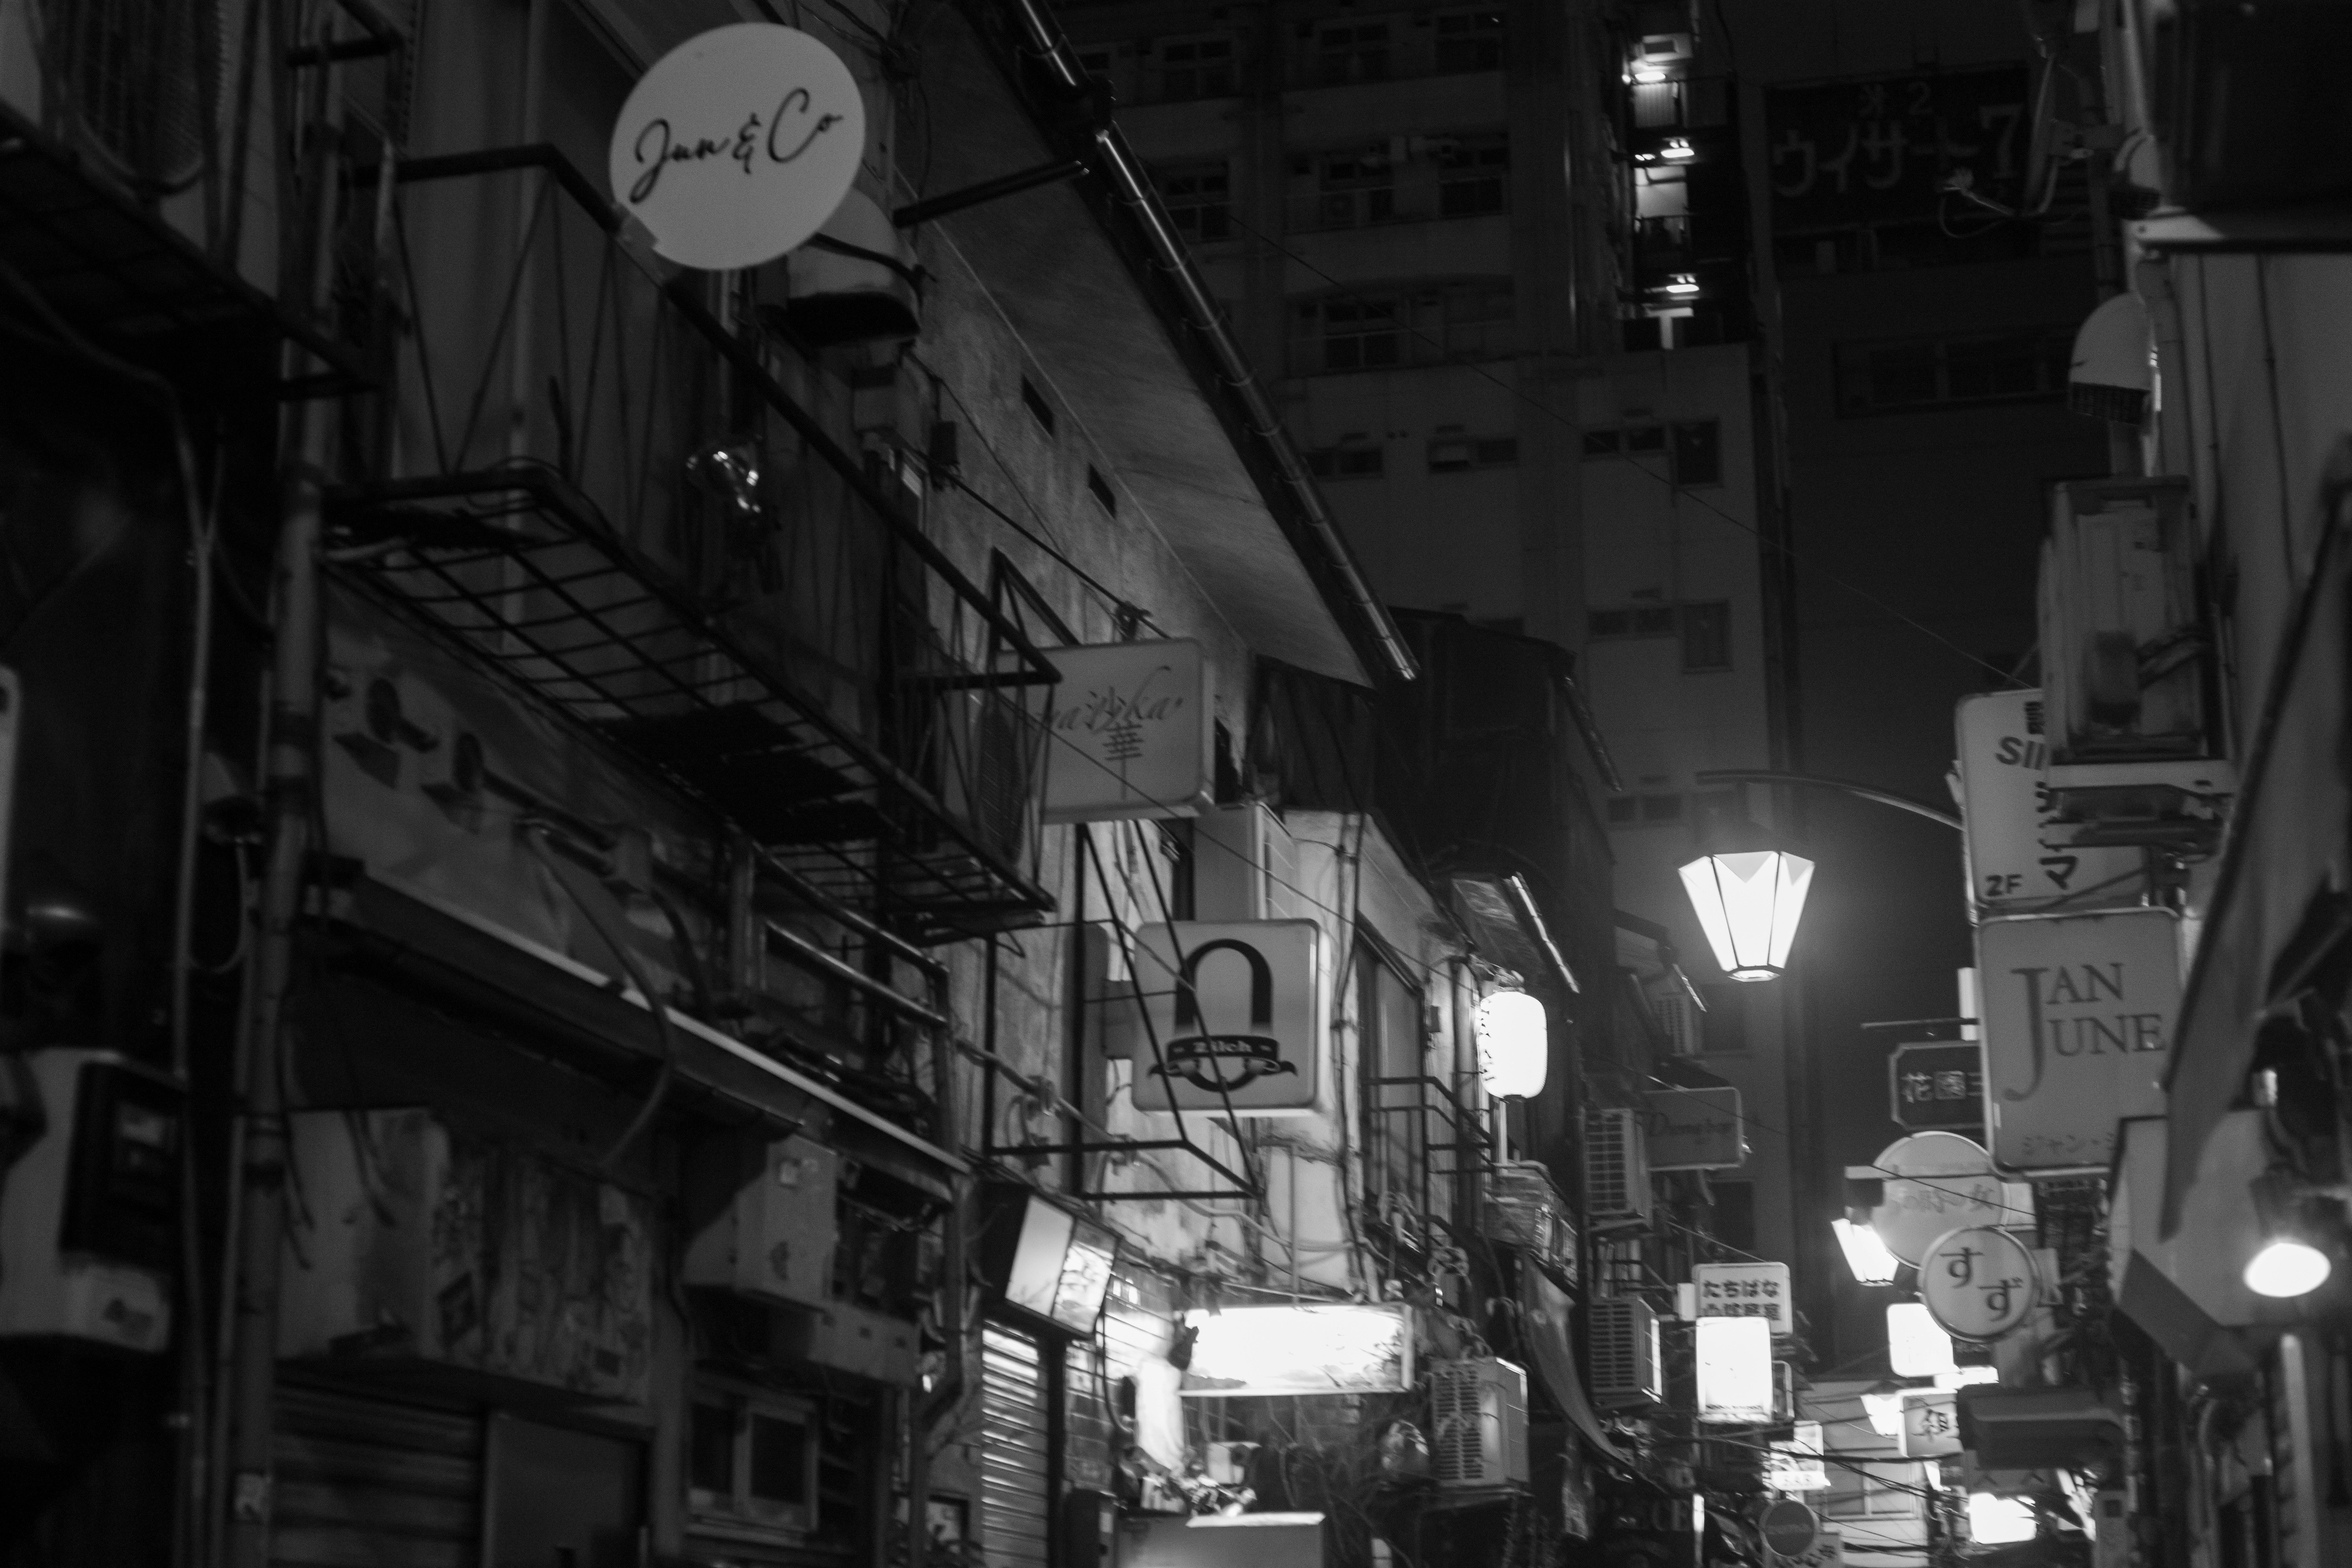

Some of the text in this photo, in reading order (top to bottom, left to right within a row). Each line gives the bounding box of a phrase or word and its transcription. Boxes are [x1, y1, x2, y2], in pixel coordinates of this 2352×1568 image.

[732, 113, 762, 174] &
[767, 88, 843, 163] Co
[1986, 873, 2023, 897] 2F
[1702, 1280, 1780, 1298] たちばな
[1940, 1246, 2024, 1322] すず
